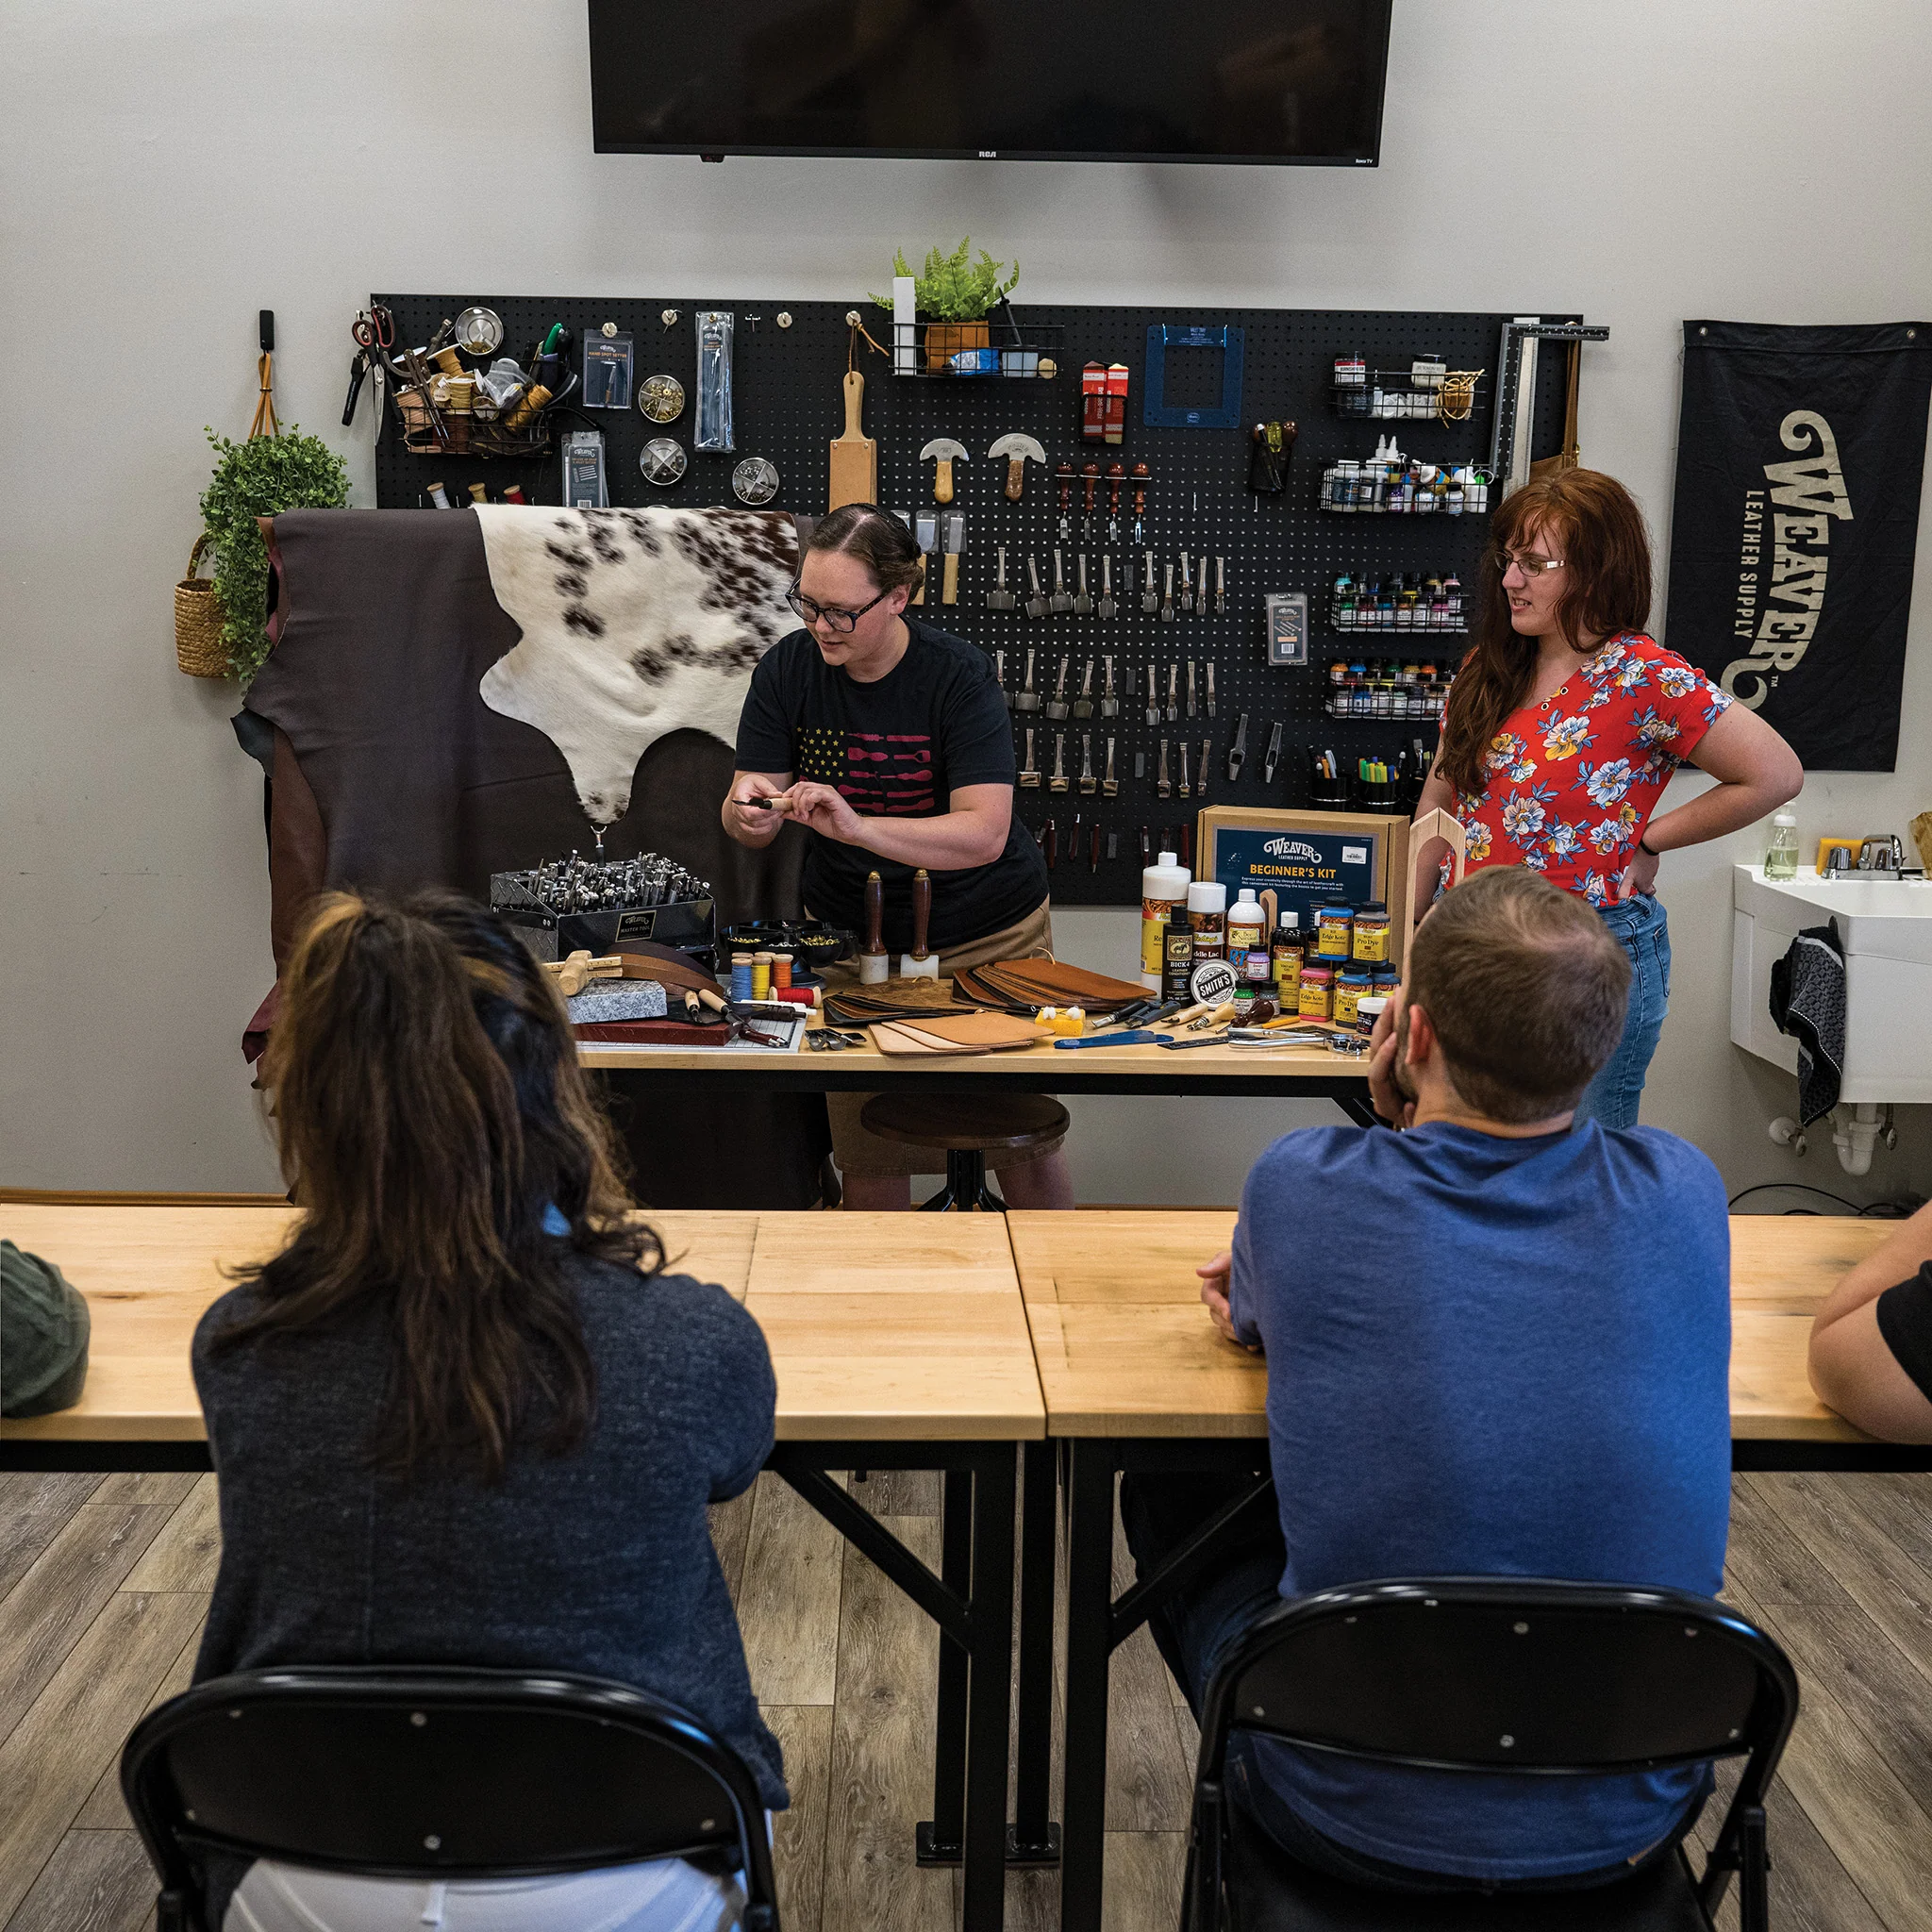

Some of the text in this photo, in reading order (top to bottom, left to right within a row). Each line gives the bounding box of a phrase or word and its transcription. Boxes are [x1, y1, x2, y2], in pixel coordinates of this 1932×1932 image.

[1721, 409, 1855, 710] WEAVER
[1734, 491, 1765, 639] LEATHER SUPPLY
[1263, 837, 1323, 864] WEAVER
[1250, 864, 1337, 879] BEGINNER'S KIT
[1367, 939, 1379, 947] Dye
[1228, 948, 1250, 967] RT
[1199, 974, 1230, 997] SMITH'S
